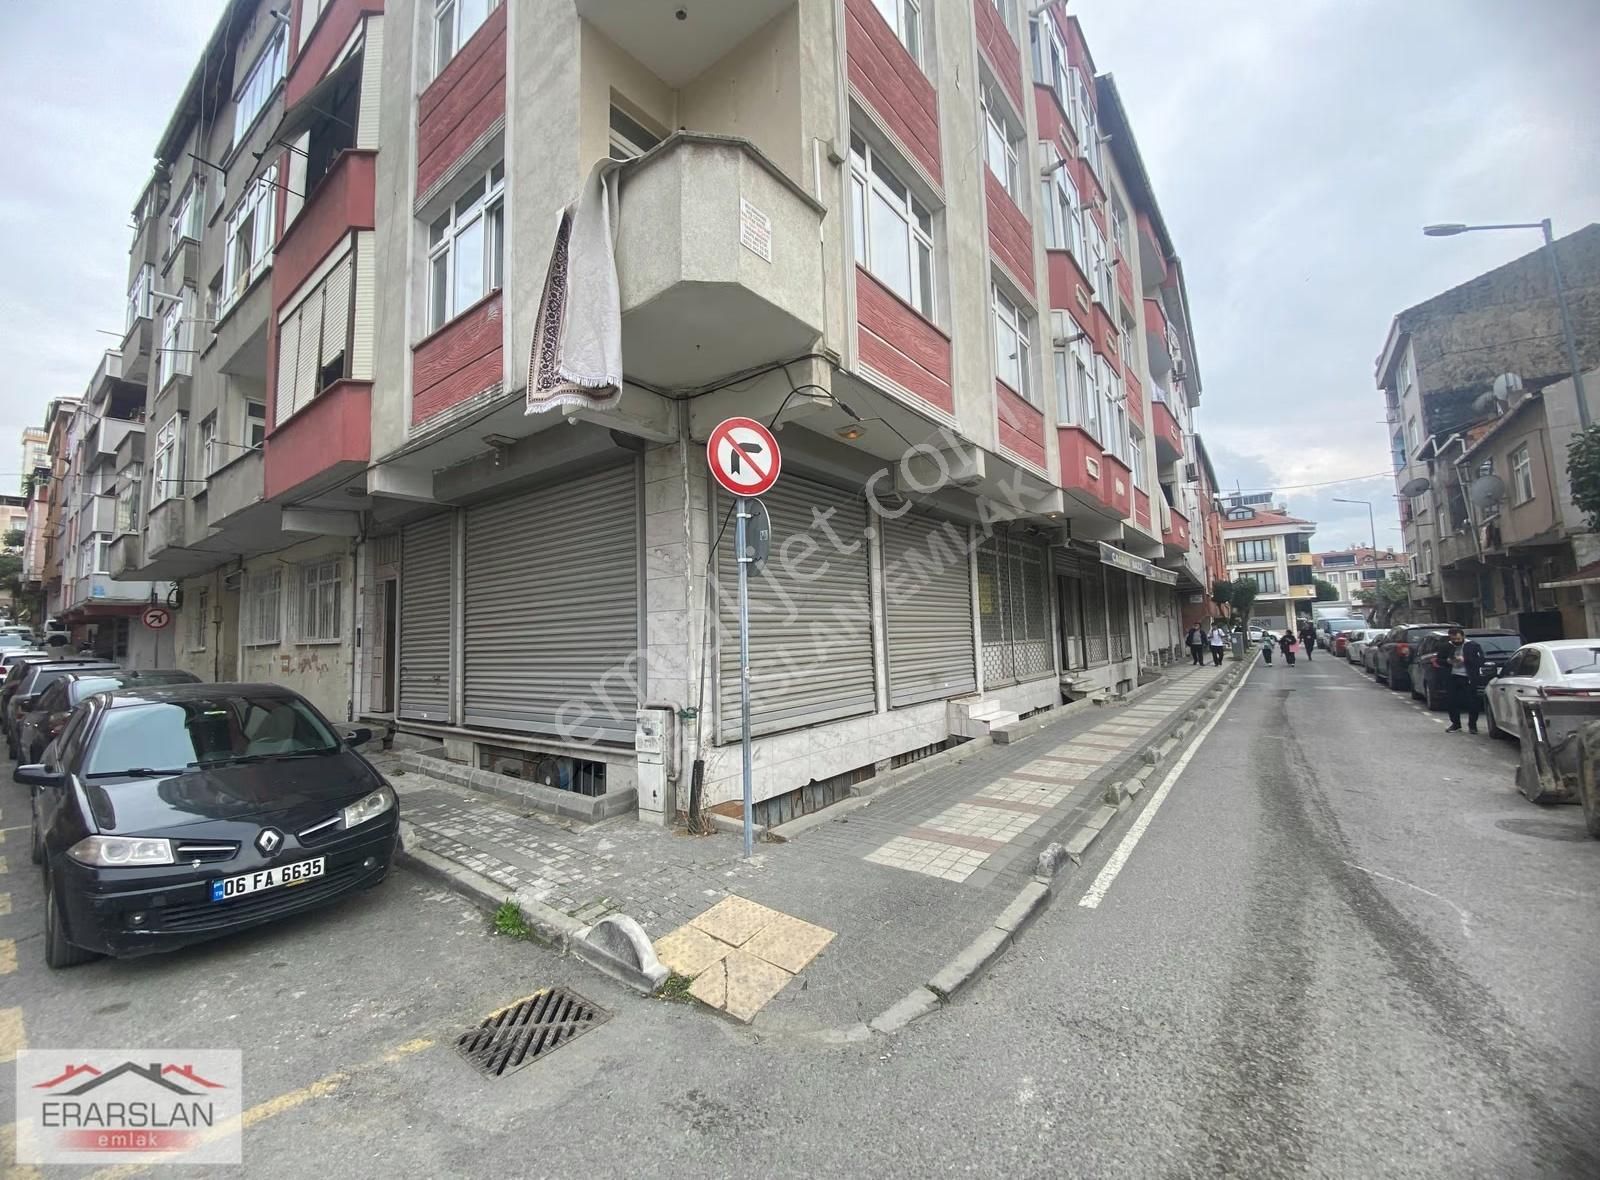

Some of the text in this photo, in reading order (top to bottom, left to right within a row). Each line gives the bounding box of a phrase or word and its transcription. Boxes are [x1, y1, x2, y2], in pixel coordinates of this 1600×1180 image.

[224, 860, 321, 896] 06 FA 6635
